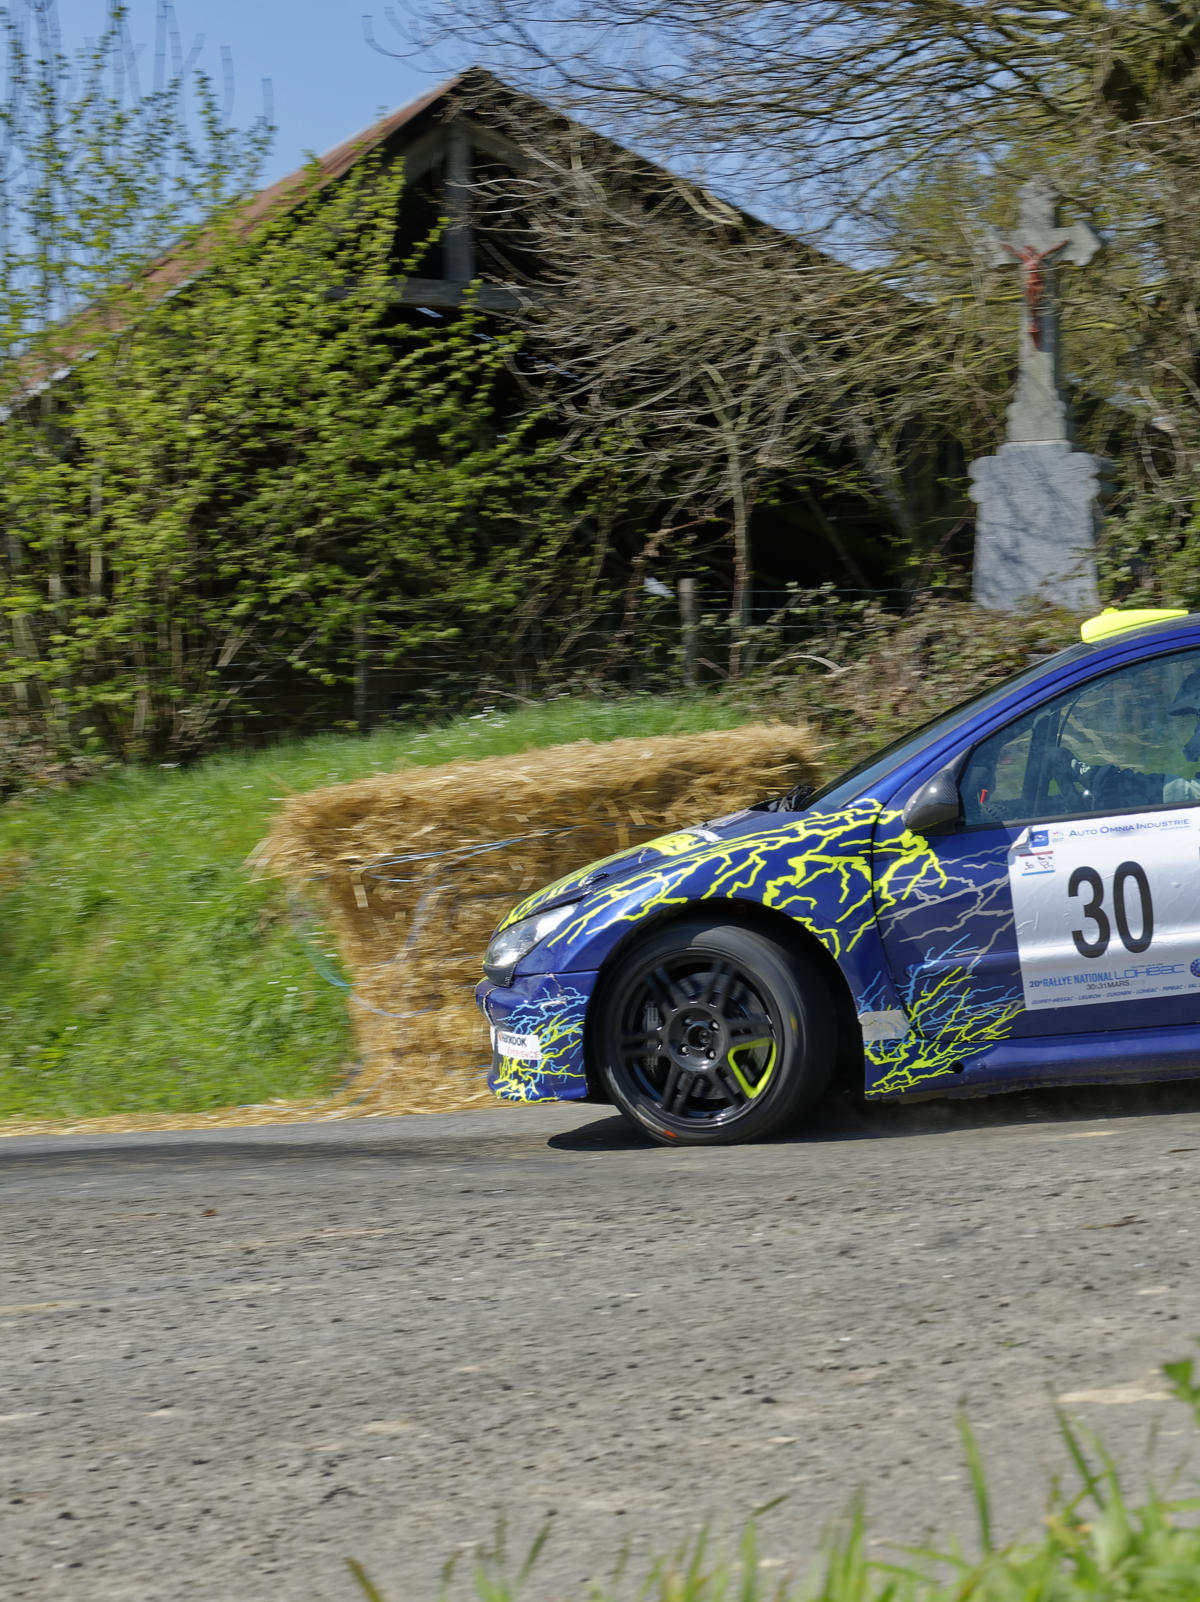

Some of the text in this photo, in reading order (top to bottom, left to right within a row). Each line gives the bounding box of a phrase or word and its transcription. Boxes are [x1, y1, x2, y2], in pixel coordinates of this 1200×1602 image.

[1068, 861, 1154, 958] 30
[1043, 975, 1073, 988] RALLYE
[1073, 971, 1115, 985] NATIONAL
